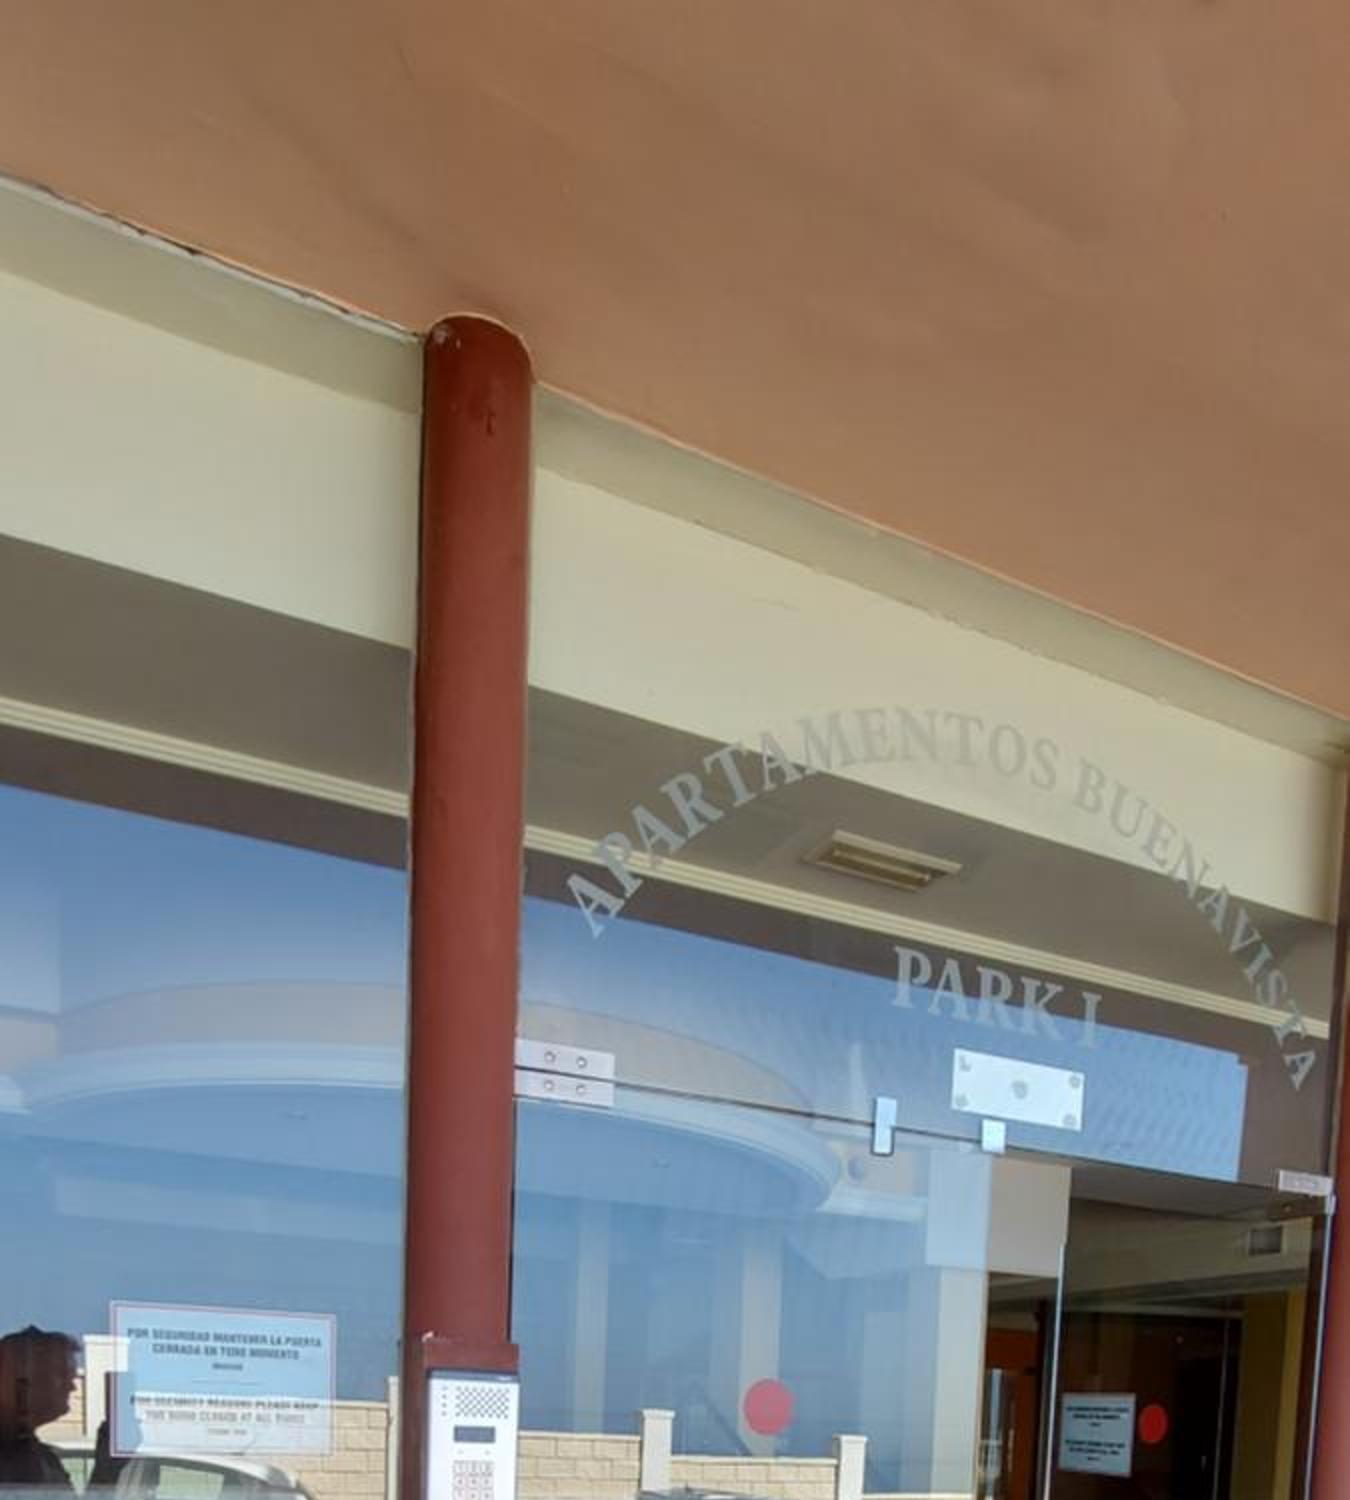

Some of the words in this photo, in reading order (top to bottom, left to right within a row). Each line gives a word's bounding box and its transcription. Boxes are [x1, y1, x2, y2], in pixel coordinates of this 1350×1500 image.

[567, 707, 1058, 938] APARTAMENTOS
[1074, 759, 1317, 1091] BUENAVISTA
[891, 945, 1063, 1040] PARK
[1075, 992, 1103, 1049] I
